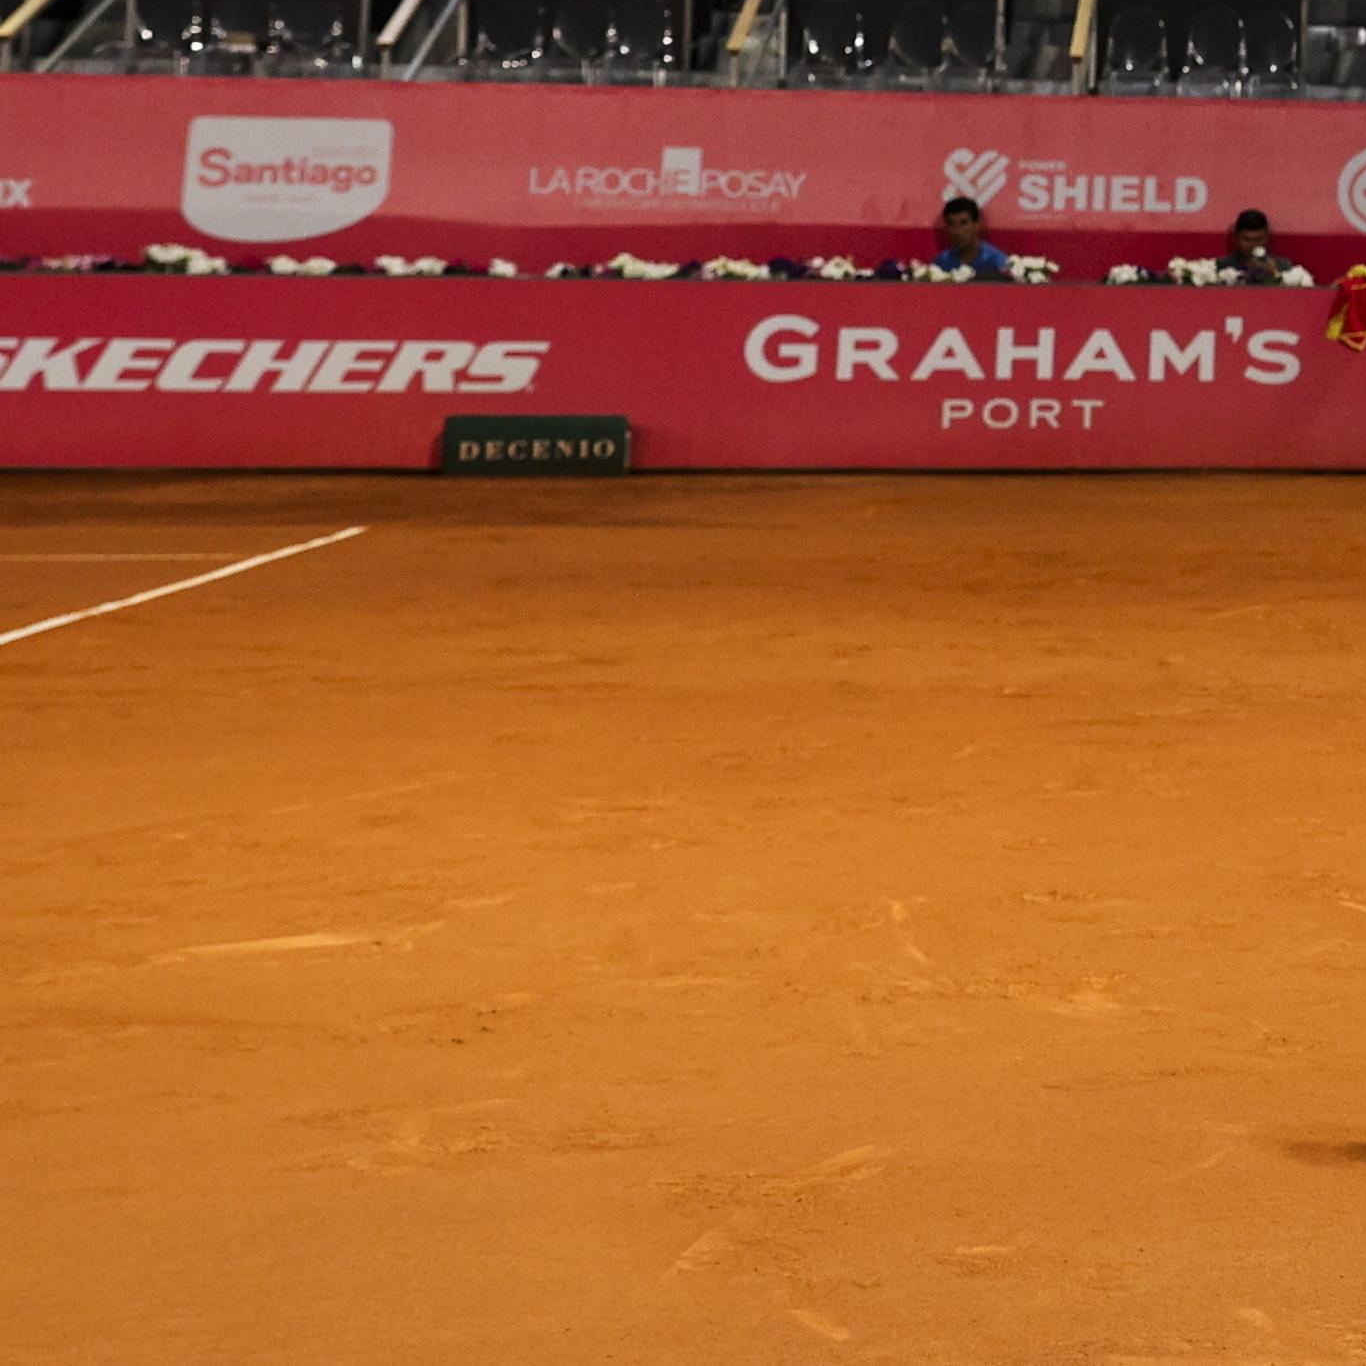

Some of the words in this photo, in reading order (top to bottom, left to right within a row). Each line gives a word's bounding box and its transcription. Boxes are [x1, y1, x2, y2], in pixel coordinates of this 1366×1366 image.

[197, 147, 379, 193] Santiago
[1018, 174, 1208, 212] SHIELD
[0, 337, 550, 394] KECHERS
[743, 313, 1301, 384] GRAHAM'S
[941, 398, 1105, 430] PORT
[457, 438, 616, 461] DECENIO
